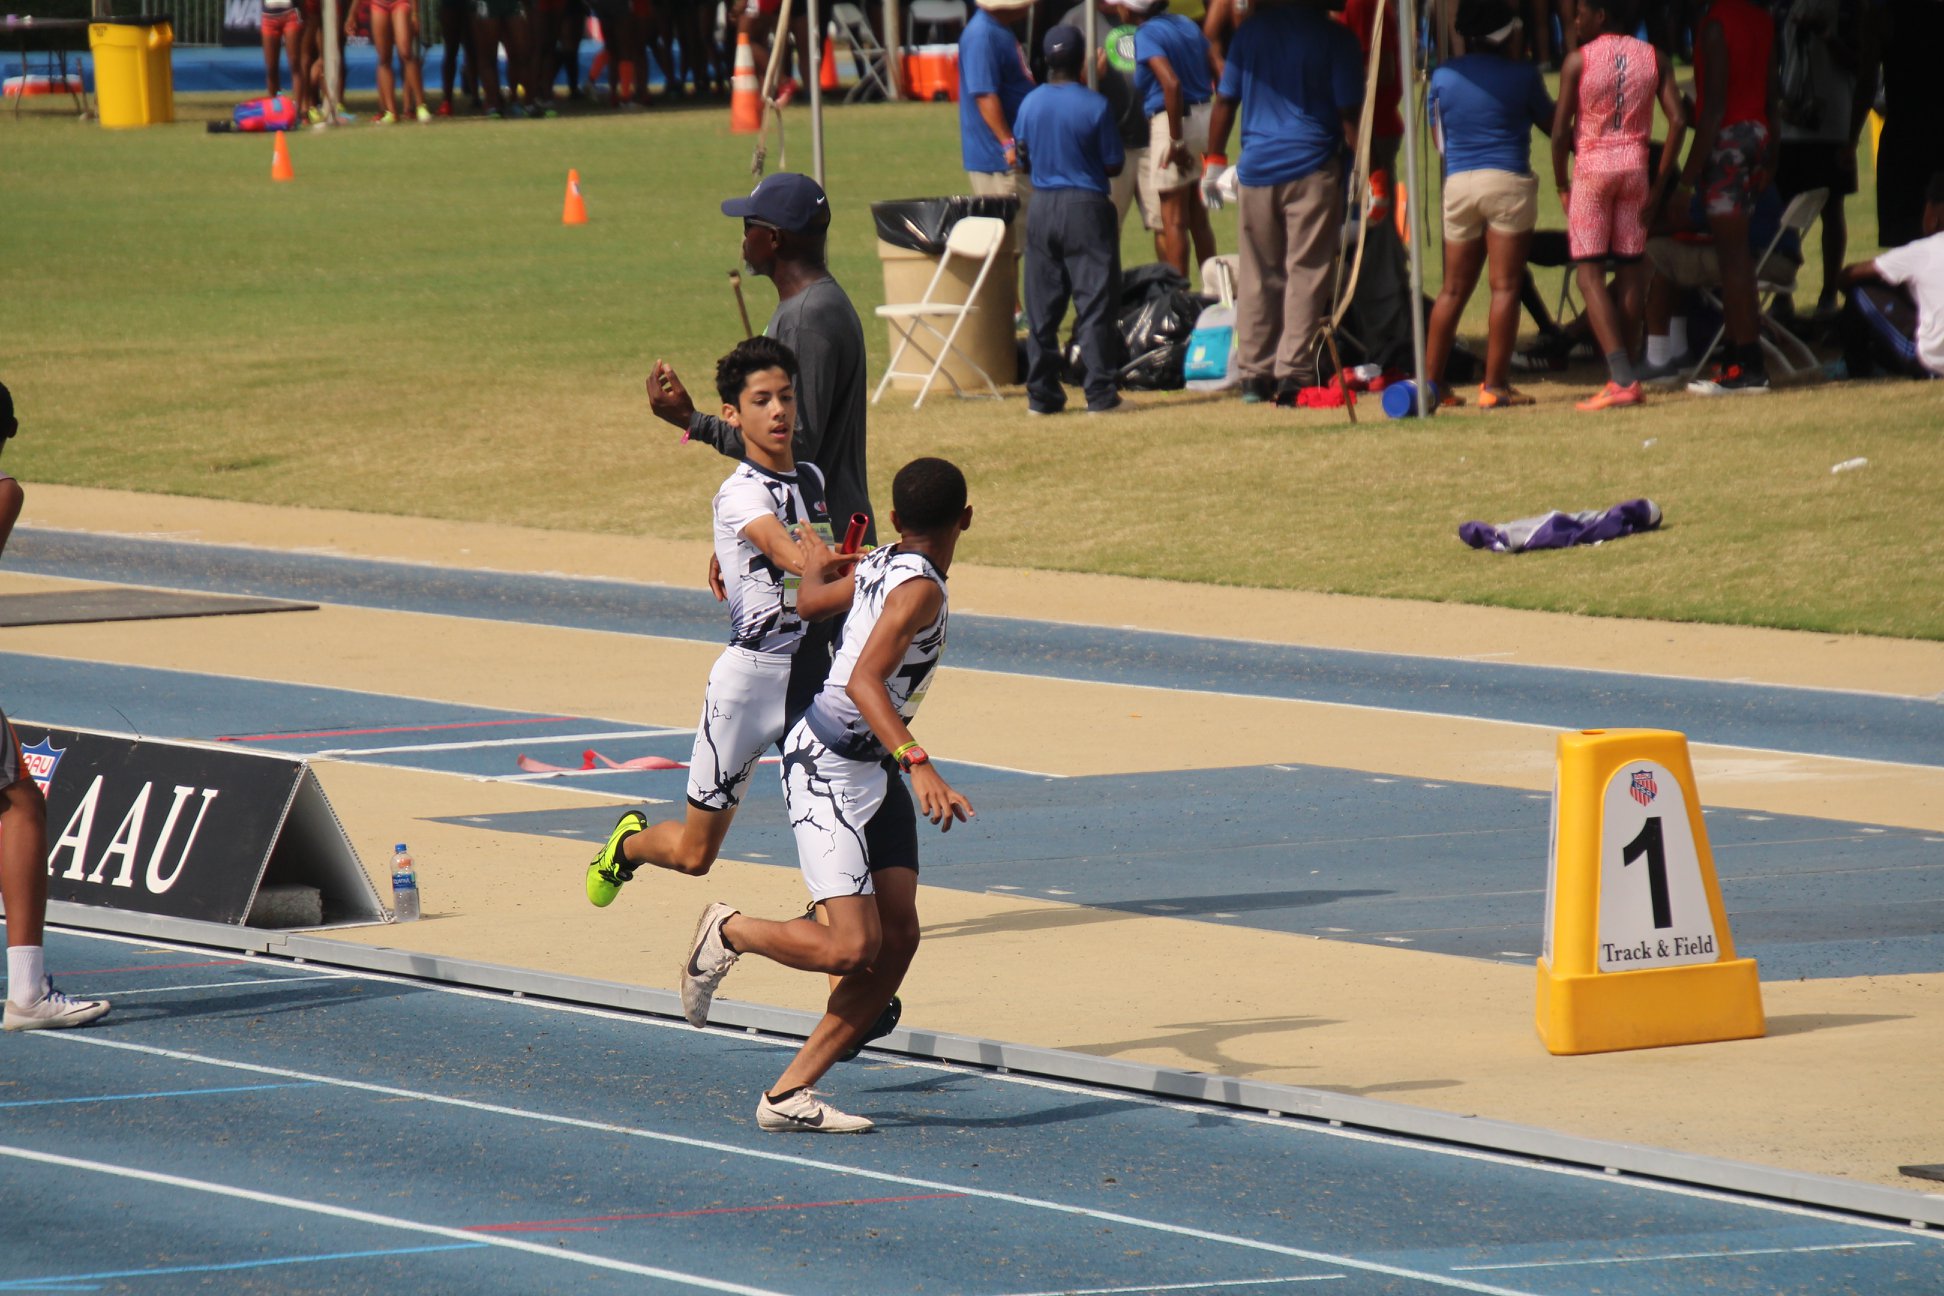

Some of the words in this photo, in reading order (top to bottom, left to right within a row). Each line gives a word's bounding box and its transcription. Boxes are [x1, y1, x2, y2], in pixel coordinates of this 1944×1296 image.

[48, 775, 218, 894] AAU
[1623, 816, 1673, 929] 1
[1603, 941, 1652, 962] Track
[1657, 940, 1670, 957] &
[1674, 935, 1714, 956] Field
